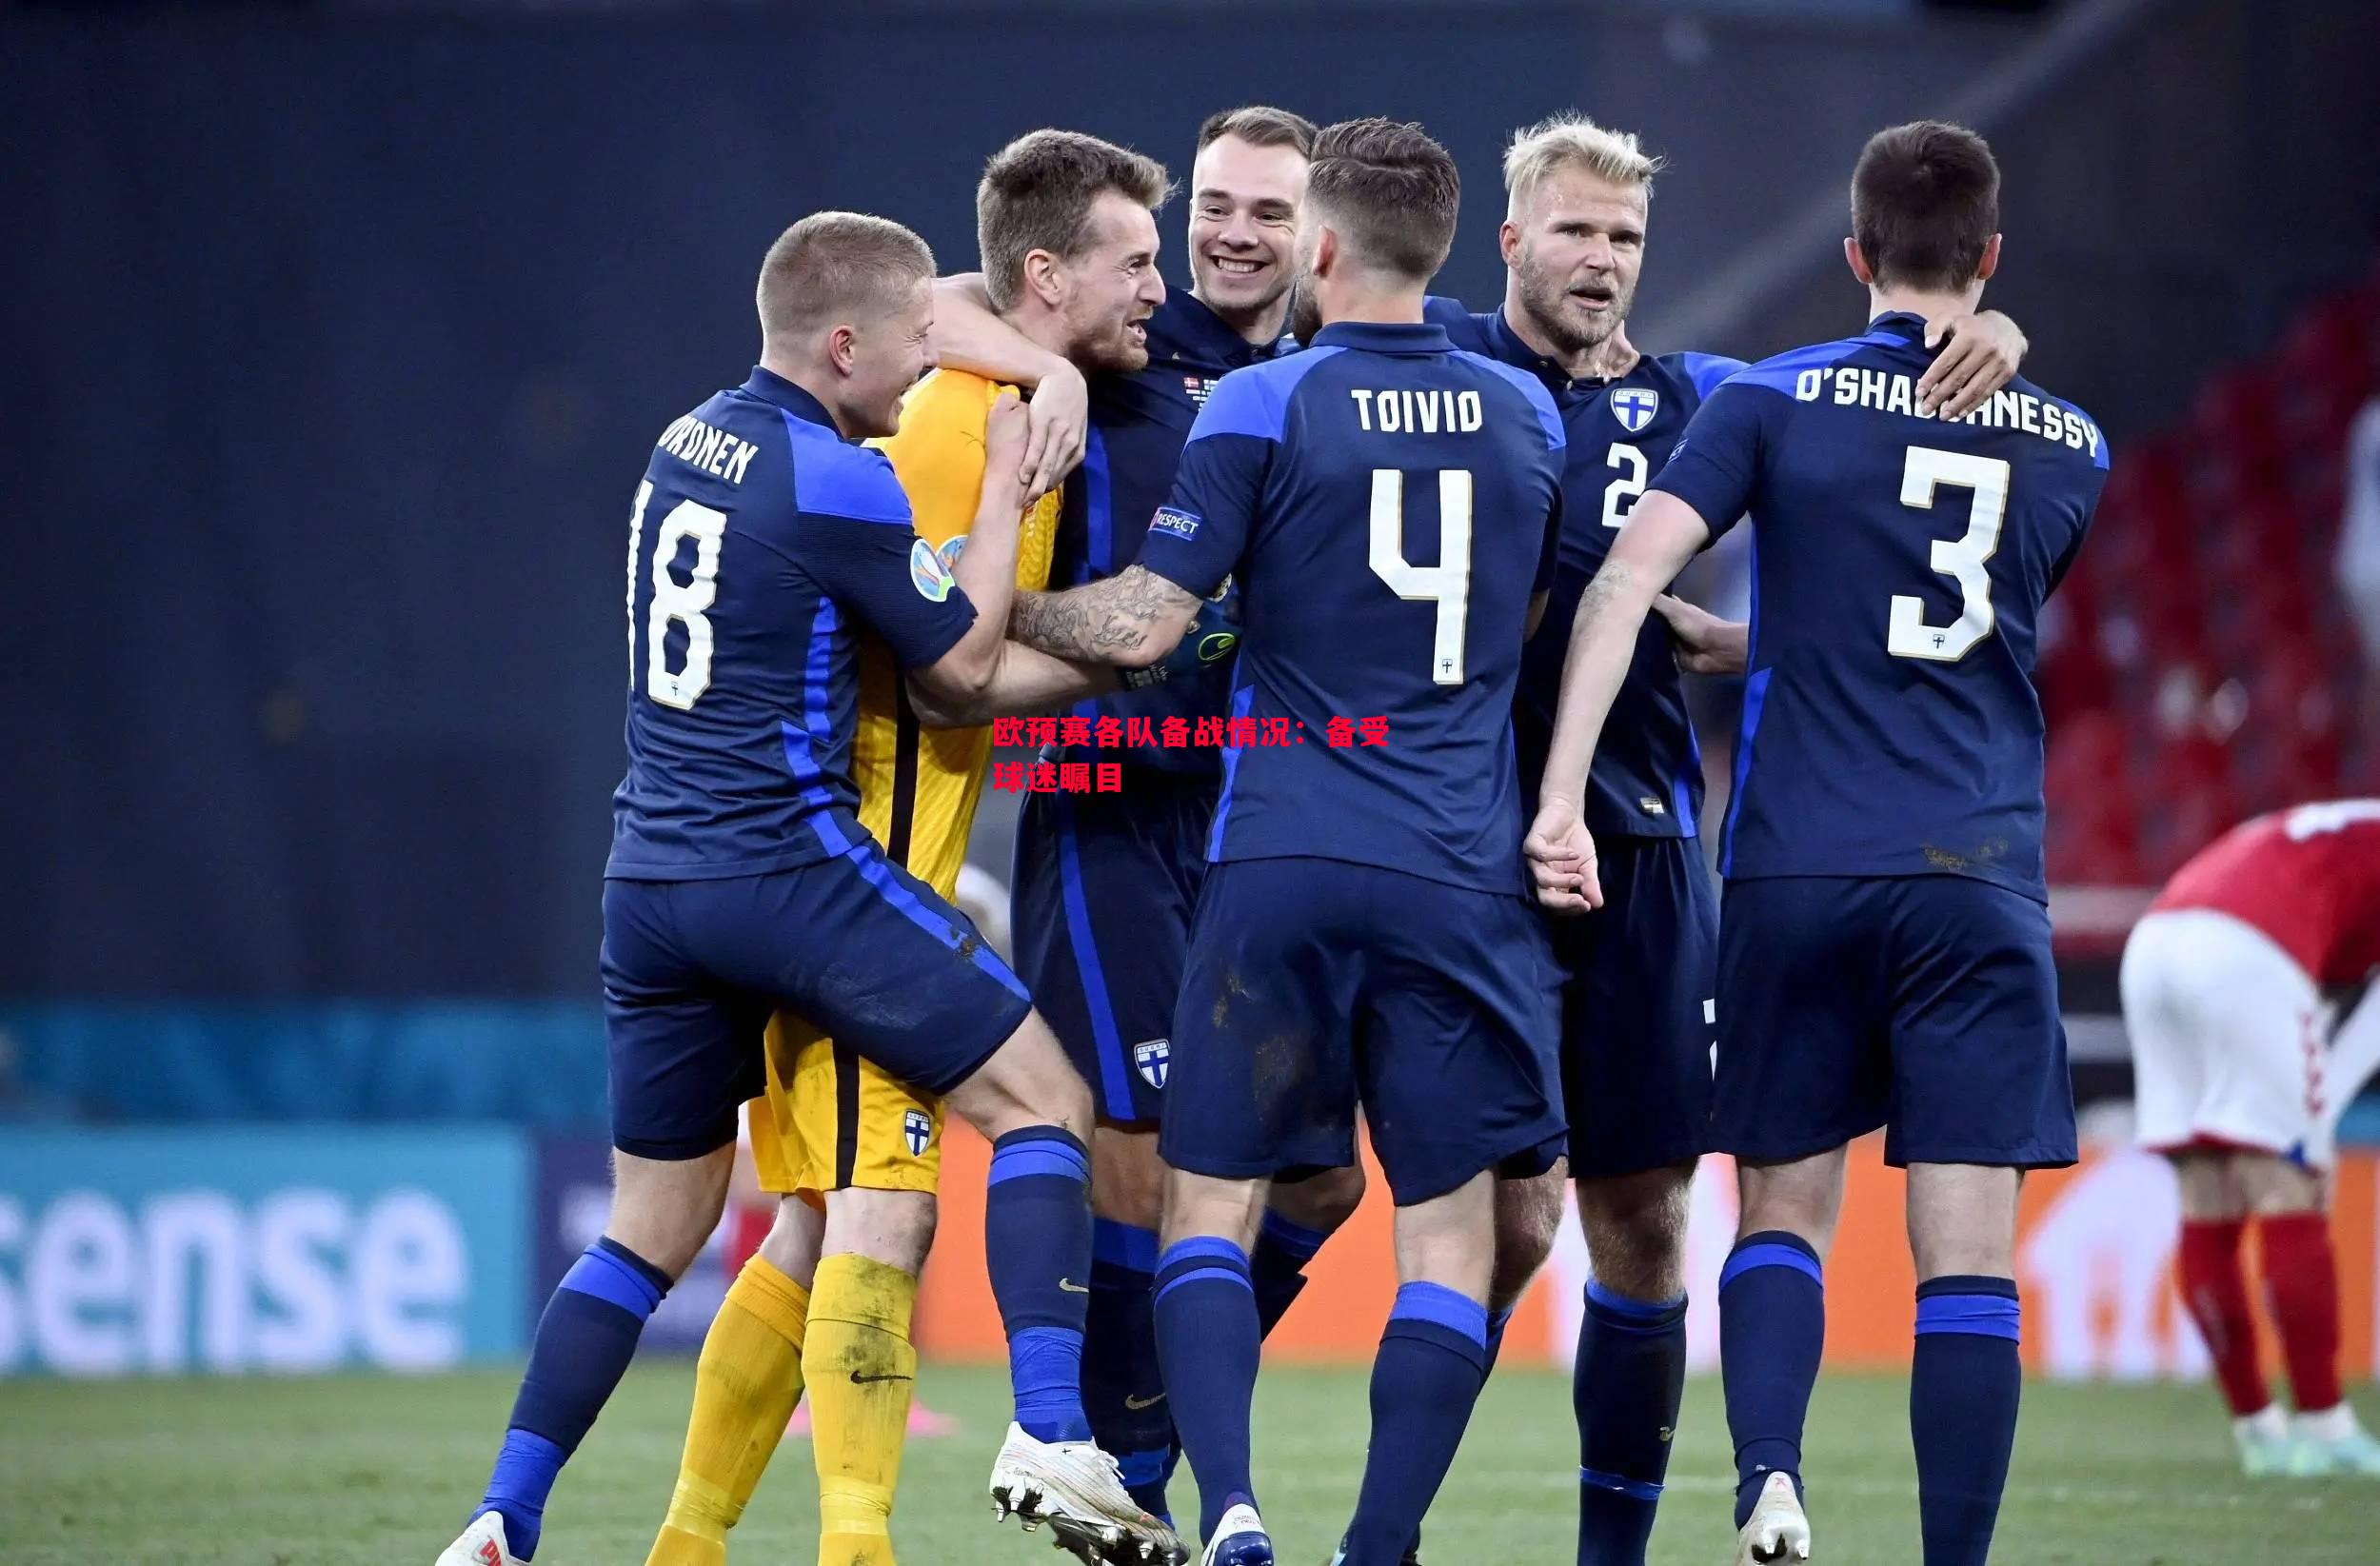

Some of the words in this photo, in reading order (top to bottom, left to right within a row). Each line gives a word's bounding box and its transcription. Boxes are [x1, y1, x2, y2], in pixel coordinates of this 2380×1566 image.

[1351, 389, 1482, 432] TOIVIO
[1795, 367, 2100, 458] O'SHAHNESSY
[1156, 513, 1199, 534] RESPECT
[1601, 443, 1650, 529] 2
[1887, 446, 2011, 662] 3
[626, 480, 727, 710] 18
[1369, 469, 1473, 685] 4
[0, 1188, 466, 1376] ense
